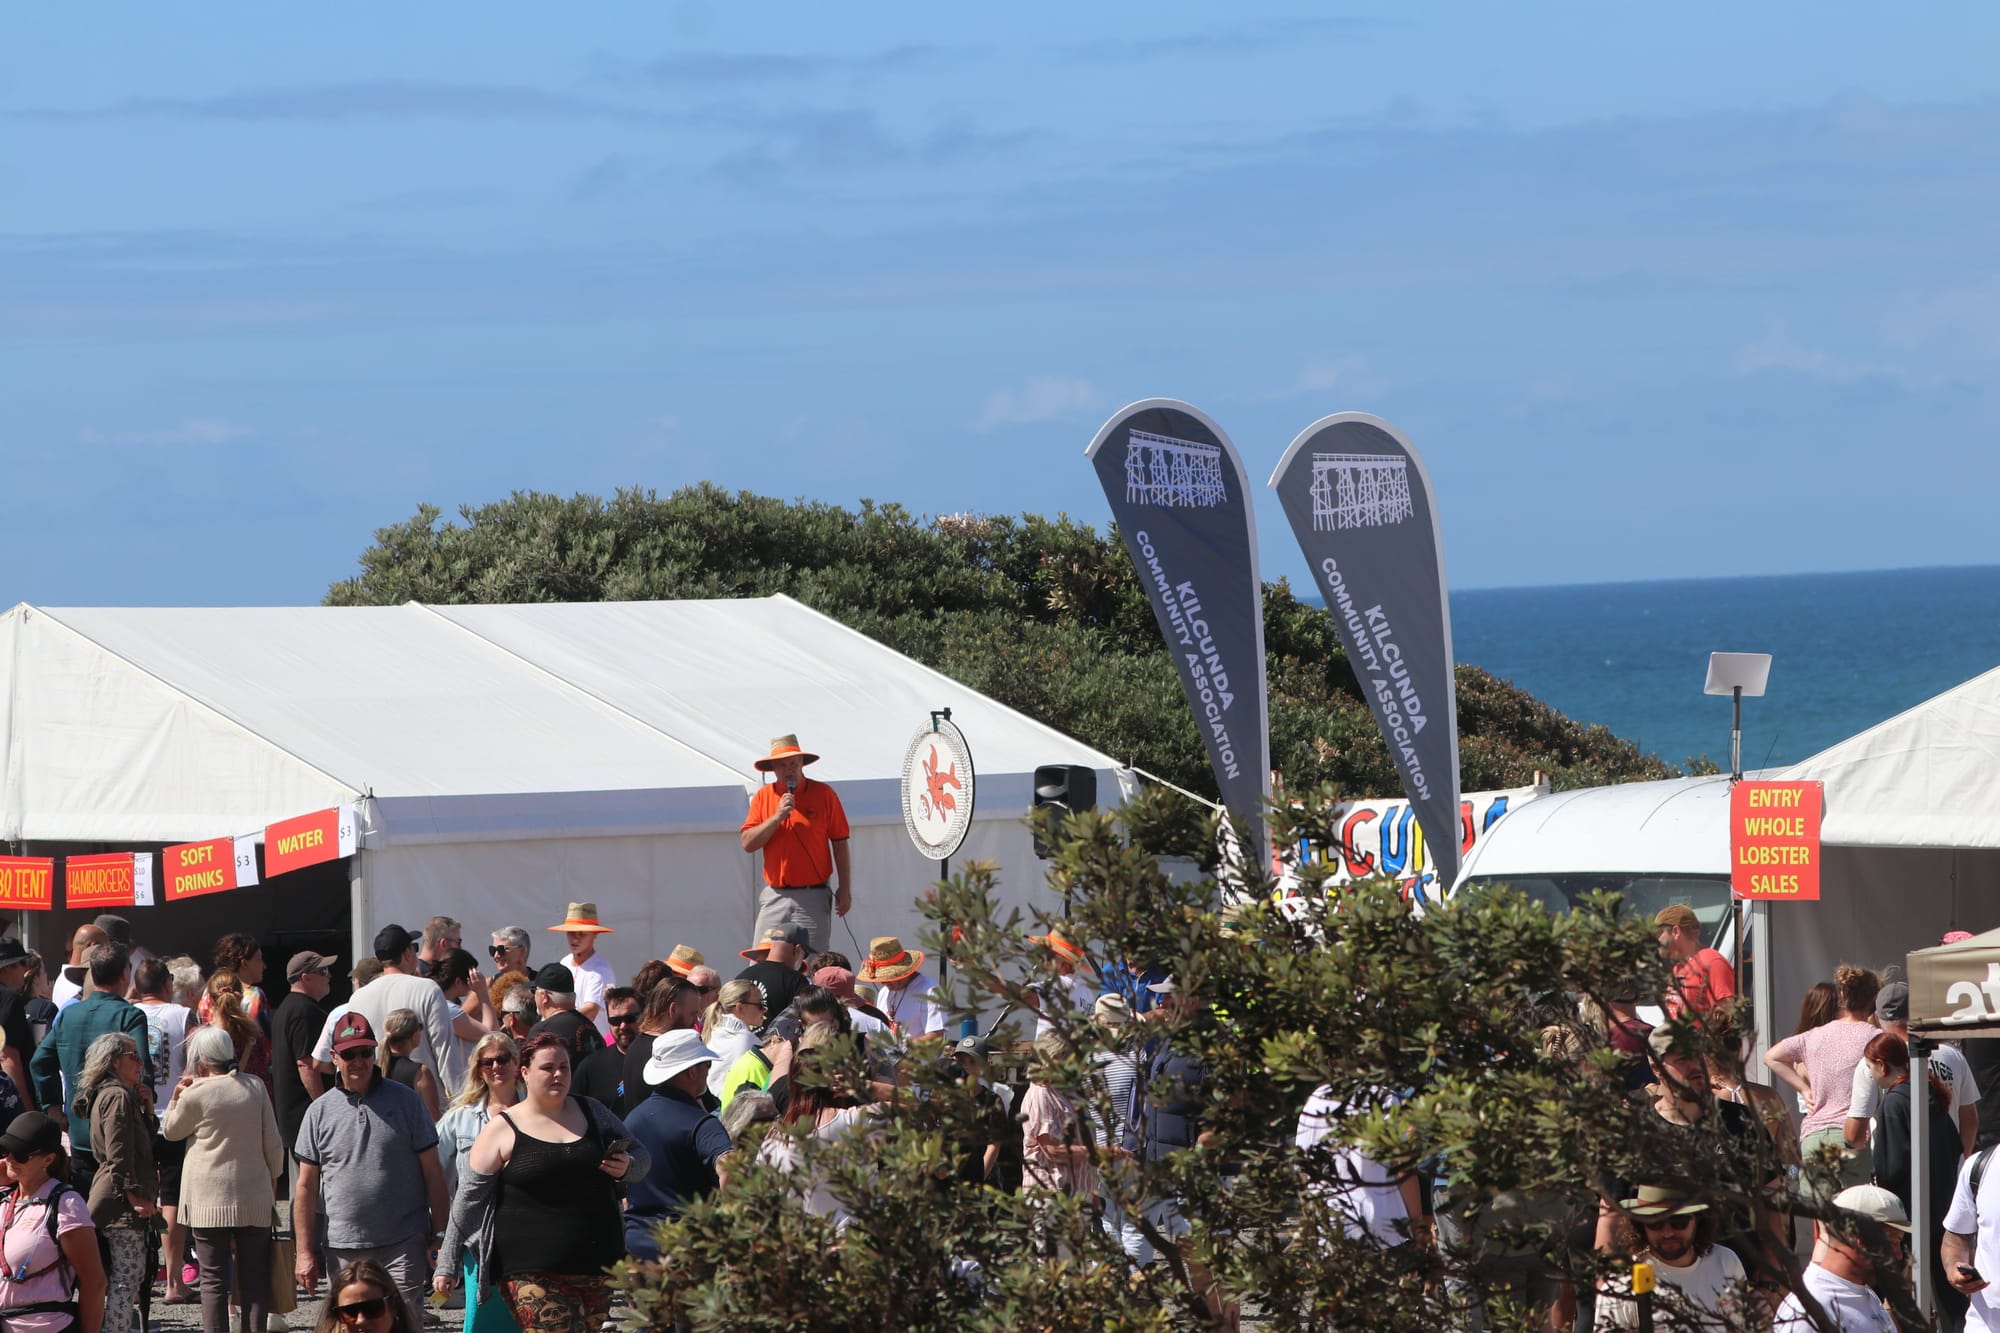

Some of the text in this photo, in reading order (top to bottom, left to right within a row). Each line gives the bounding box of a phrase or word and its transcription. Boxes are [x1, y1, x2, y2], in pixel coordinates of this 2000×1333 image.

[1136, 530, 1240, 781] COMMUNITY ASSOCIATION
[1175, 580, 1235, 712] KILCUNDA
[1322, 557, 1431, 801] COMMUNITY ASSOCIATION
[1364, 604, 1428, 735] KILCUNDA
[1749, 789, 1803, 808] ENTRY
[1744, 817, 1805, 836] WHOLE
[180, 845, 214, 867] SOFT
[277, 829, 324, 856] WATER
[1739, 846, 1810, 865] LOBSTER
[15, 868, 48, 899] TENT
[68, 867, 130, 895] HAMBURGERS
[175, 869, 224, 894] DRINKS
[1751, 875, 1799, 894] SALES
